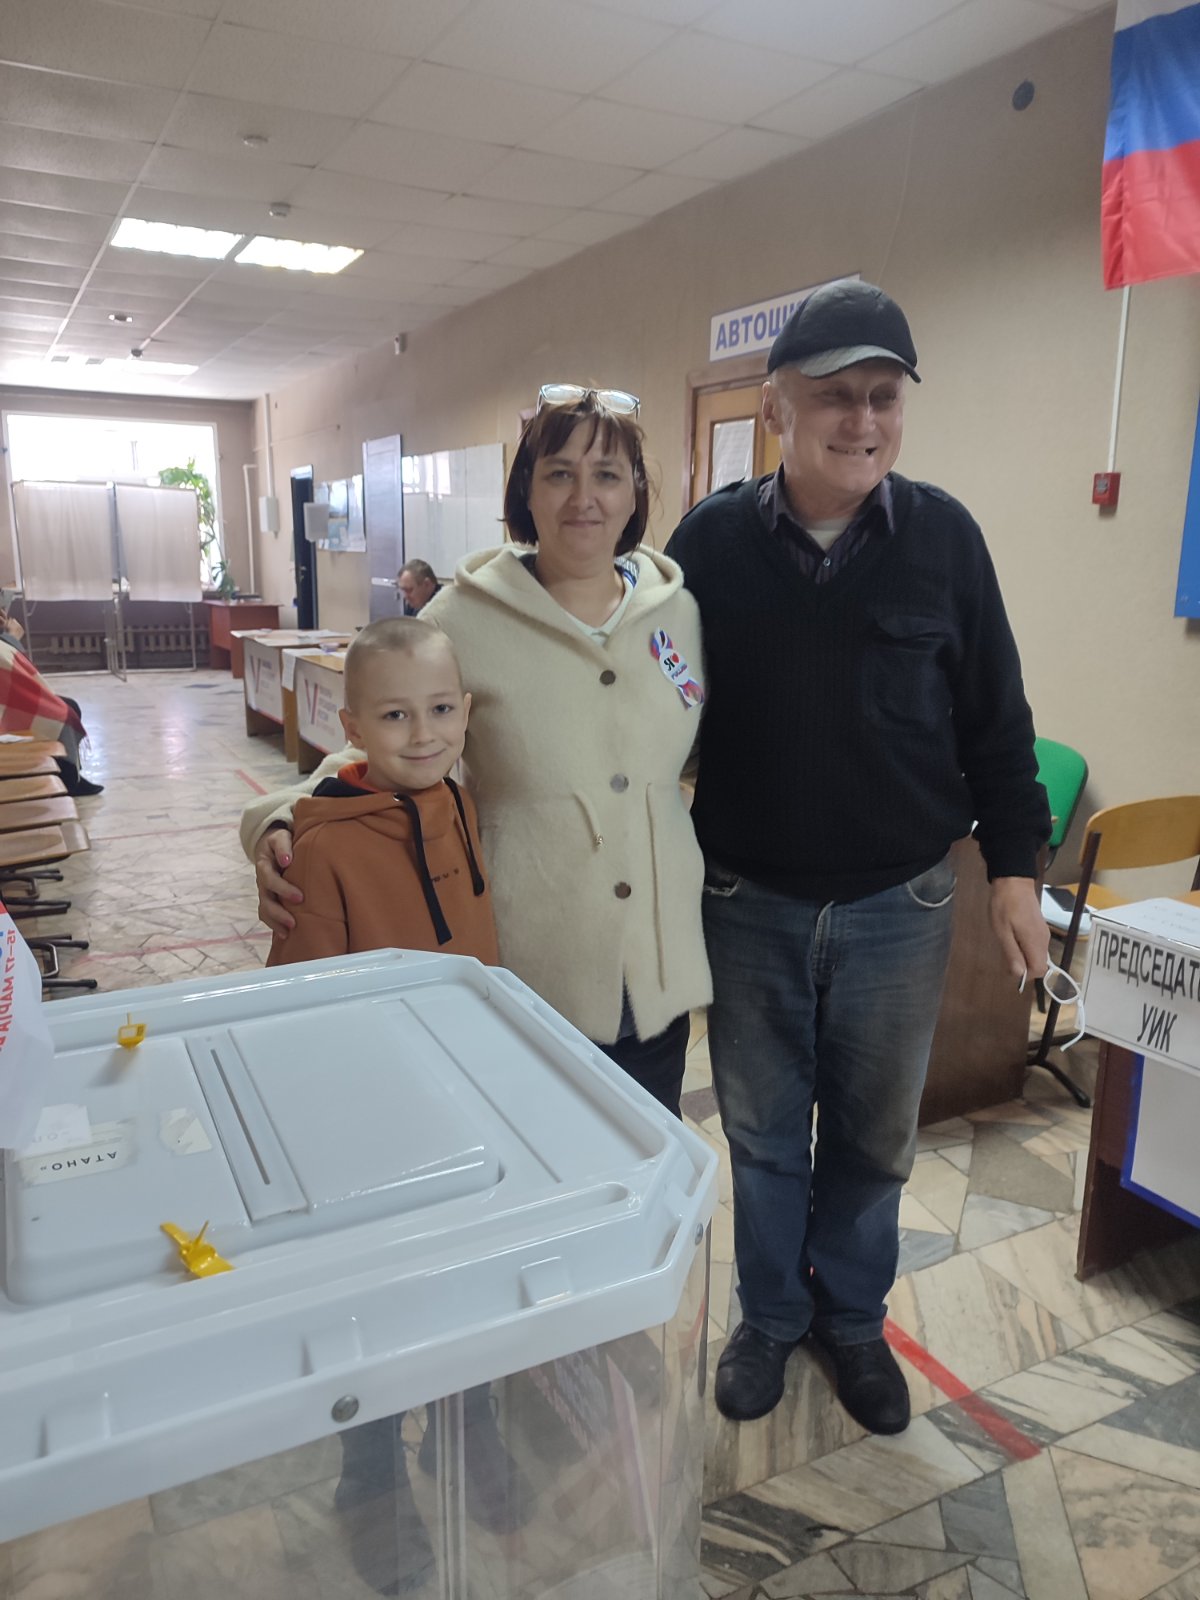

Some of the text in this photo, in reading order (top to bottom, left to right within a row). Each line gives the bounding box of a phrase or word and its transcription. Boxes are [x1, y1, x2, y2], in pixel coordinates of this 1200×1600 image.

[664, 657, 675, 671] Я
[1096, 929, 1200, 1002] ПРЕДСЕДАТ
[1136, 1003, 1178, 1053] УИК
